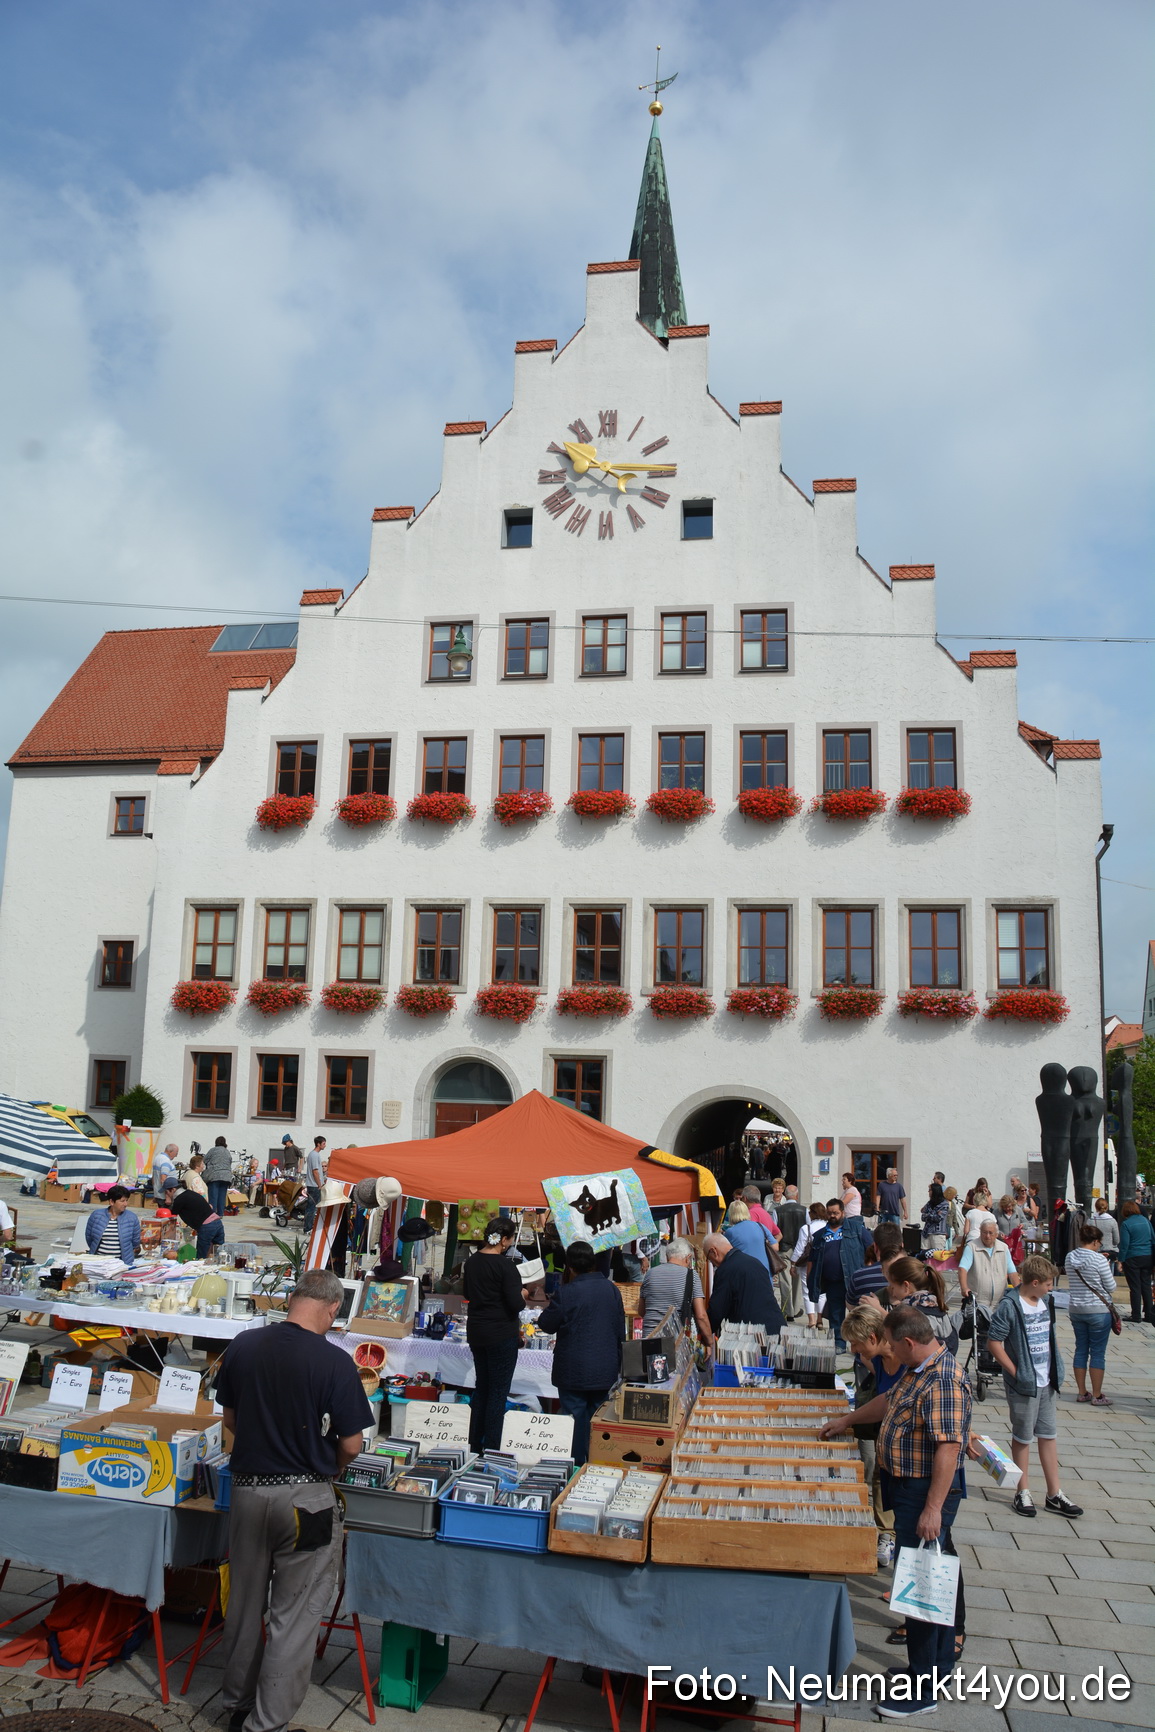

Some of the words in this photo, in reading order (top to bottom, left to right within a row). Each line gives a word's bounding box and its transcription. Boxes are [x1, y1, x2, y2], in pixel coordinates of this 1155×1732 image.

[598, 410, 617, 437] XII
[627, 415, 644, 441] I
[567, 418, 594, 444] XI
[641, 435, 670, 457] II
[538, 468, 567, 484] IX
[565, 503, 592, 536] VII
[626, 504, 646, 530] V
[599, 510, 614, 539] VI
[1025, 1325, 1042, 1333] didas
[61, 1367, 81, 1376] Singles
[171, 1370, 192, 1380] Singles
[69, 1379, 82, 1388] Euro
[108, 1374, 128, 1384] Singles
[117, 1386, 130, 1395] Euro
[180, 1383, 194, 1392] Euro
[430, 1404, 449, 1414] DVD
[438, 1420, 453, 1428] Euro
[530, 1415, 551, 1425] DVD
[63, 1431, 101, 1443] BANANAS
[407, 1430, 414, 1438] 3
[538, 1430, 554, 1438] Euro
[103, 1436, 142, 1449] PREMIUM
[506, 1439, 513, 1448] 3
[514, 1442, 533, 1450] Stück
[105, 1451, 130, 1459] QUALITY
[91, 1457, 142, 1488] derby
[60, 1475, 88, 1484] COLOMBIA
[70, 1481, 96, 1490] PRODUCE
